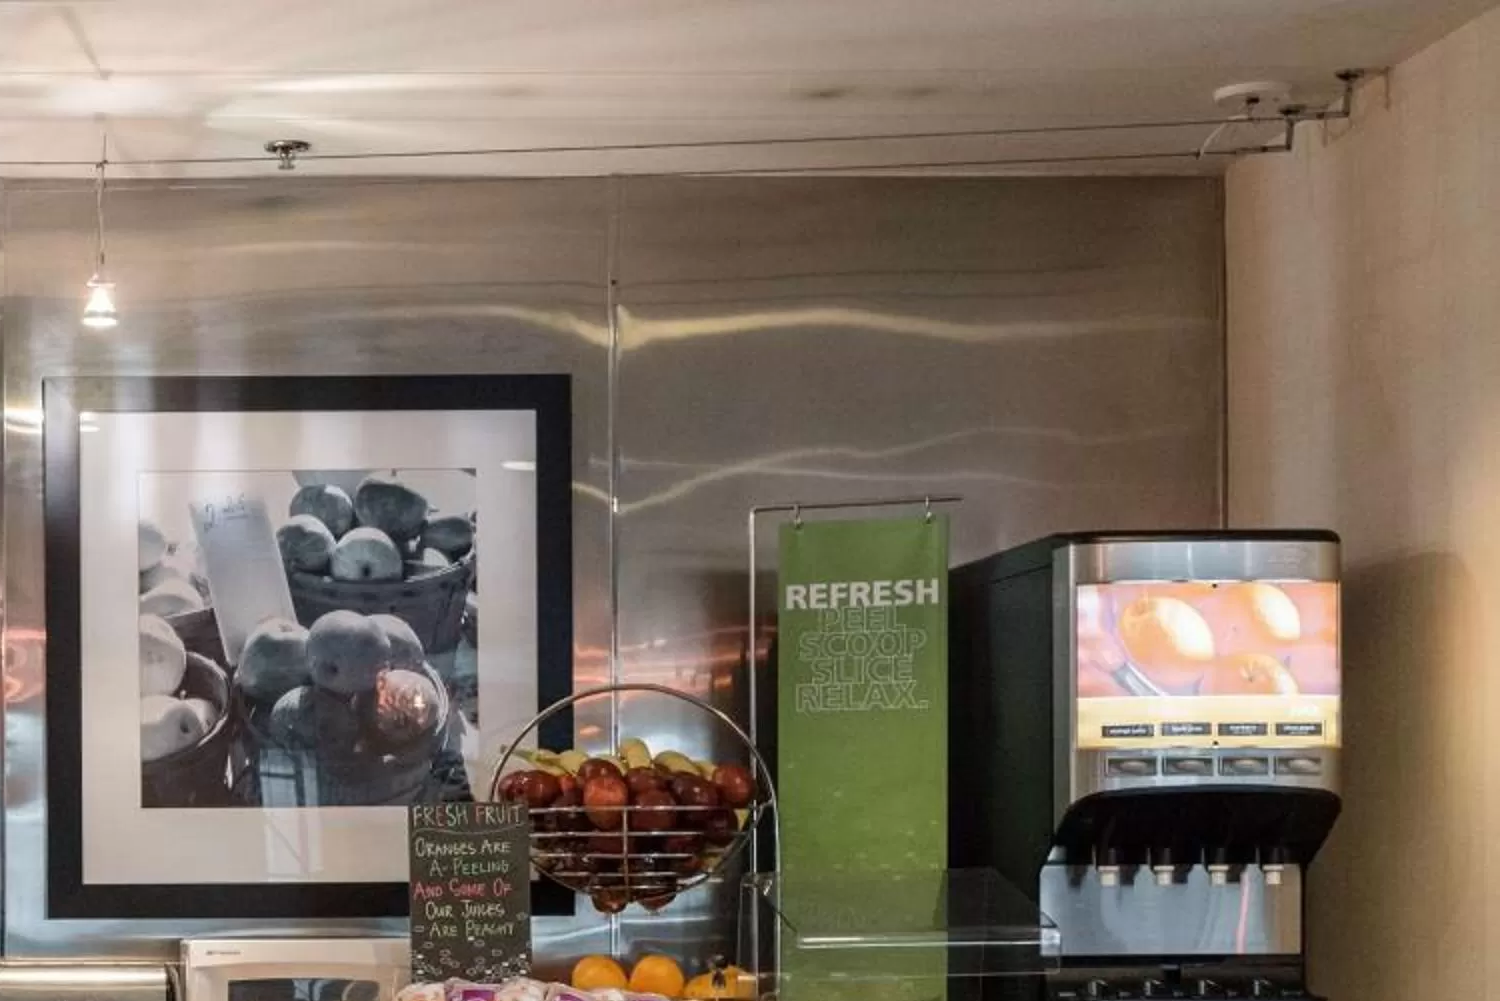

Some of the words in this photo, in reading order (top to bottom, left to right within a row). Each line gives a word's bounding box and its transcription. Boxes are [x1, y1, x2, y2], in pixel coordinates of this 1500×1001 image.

[785, 578, 939, 610] REFRESH
[818, 605, 907, 634] PEEL
[799, 628, 928, 662] SCOOP
[811, 655, 915, 685] SLICE
[413, 804, 469, 828] FRESH
[475, 803, 524, 827] FRUIT
[480, 840, 512, 855] ARE
[414, 882, 444, 900] AND
[449, 878, 486, 898] SOME
[493, 878, 513, 897] OF
[425, 900, 453, 921] OUR
[429, 921, 457, 937] ARE
